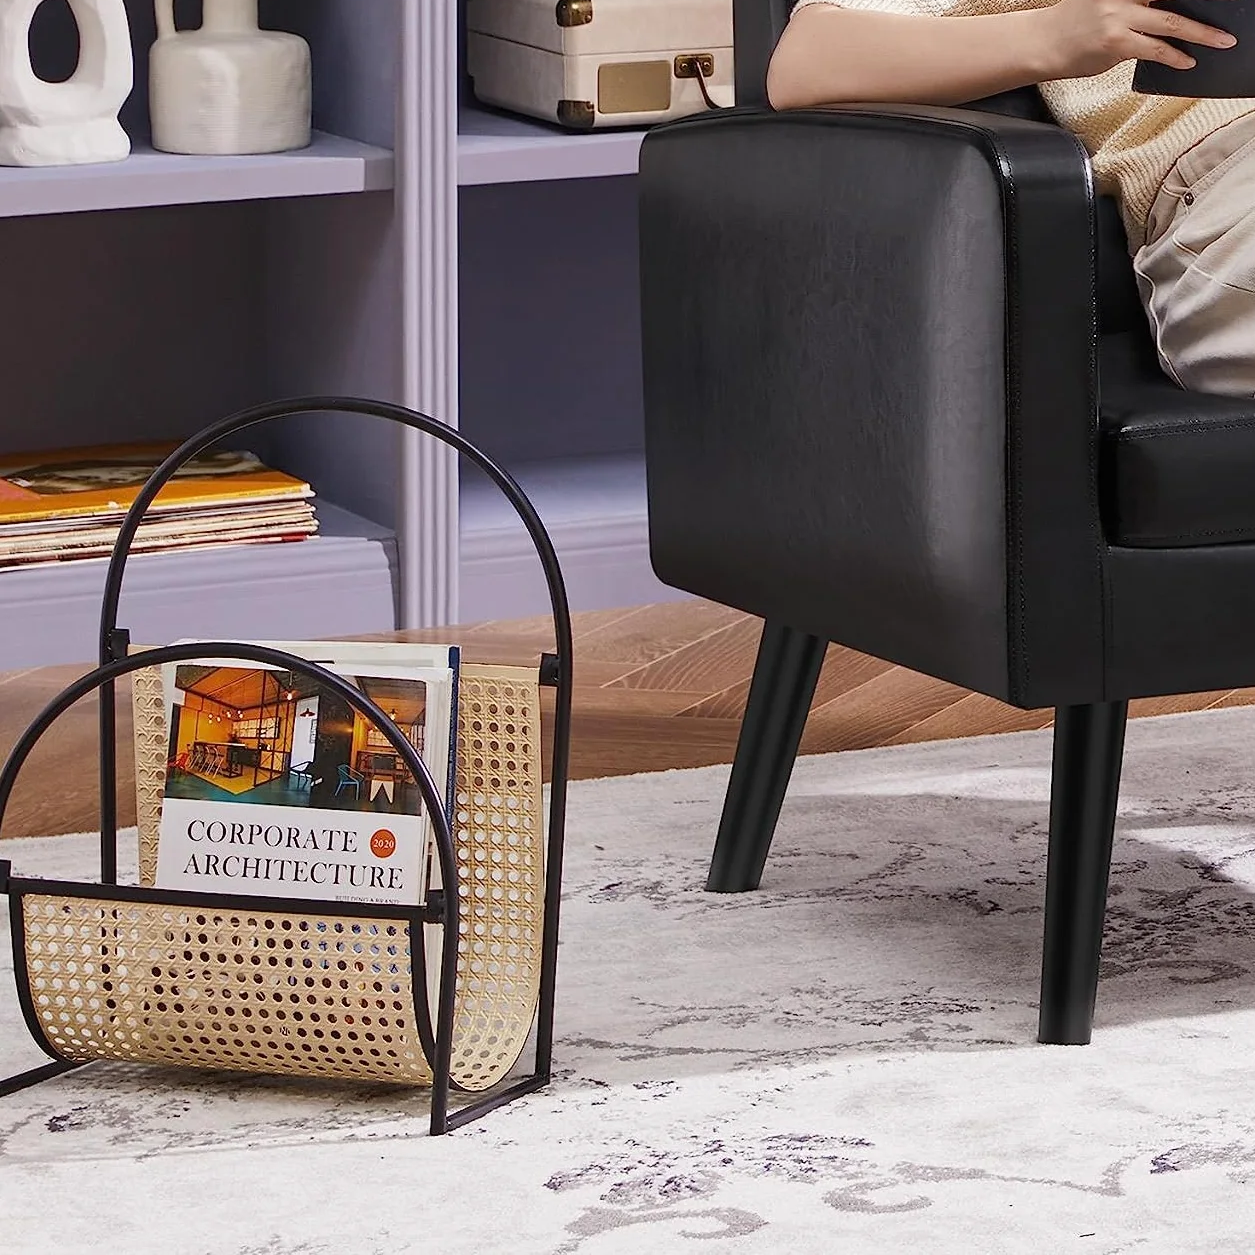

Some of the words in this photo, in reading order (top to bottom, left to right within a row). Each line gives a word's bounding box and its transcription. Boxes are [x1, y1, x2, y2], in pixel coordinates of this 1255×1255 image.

[186, 819, 358, 853] CORPORATE
[373, 838, 394, 849] 2020
[183, 853, 403, 890] ARCHITECTURE
